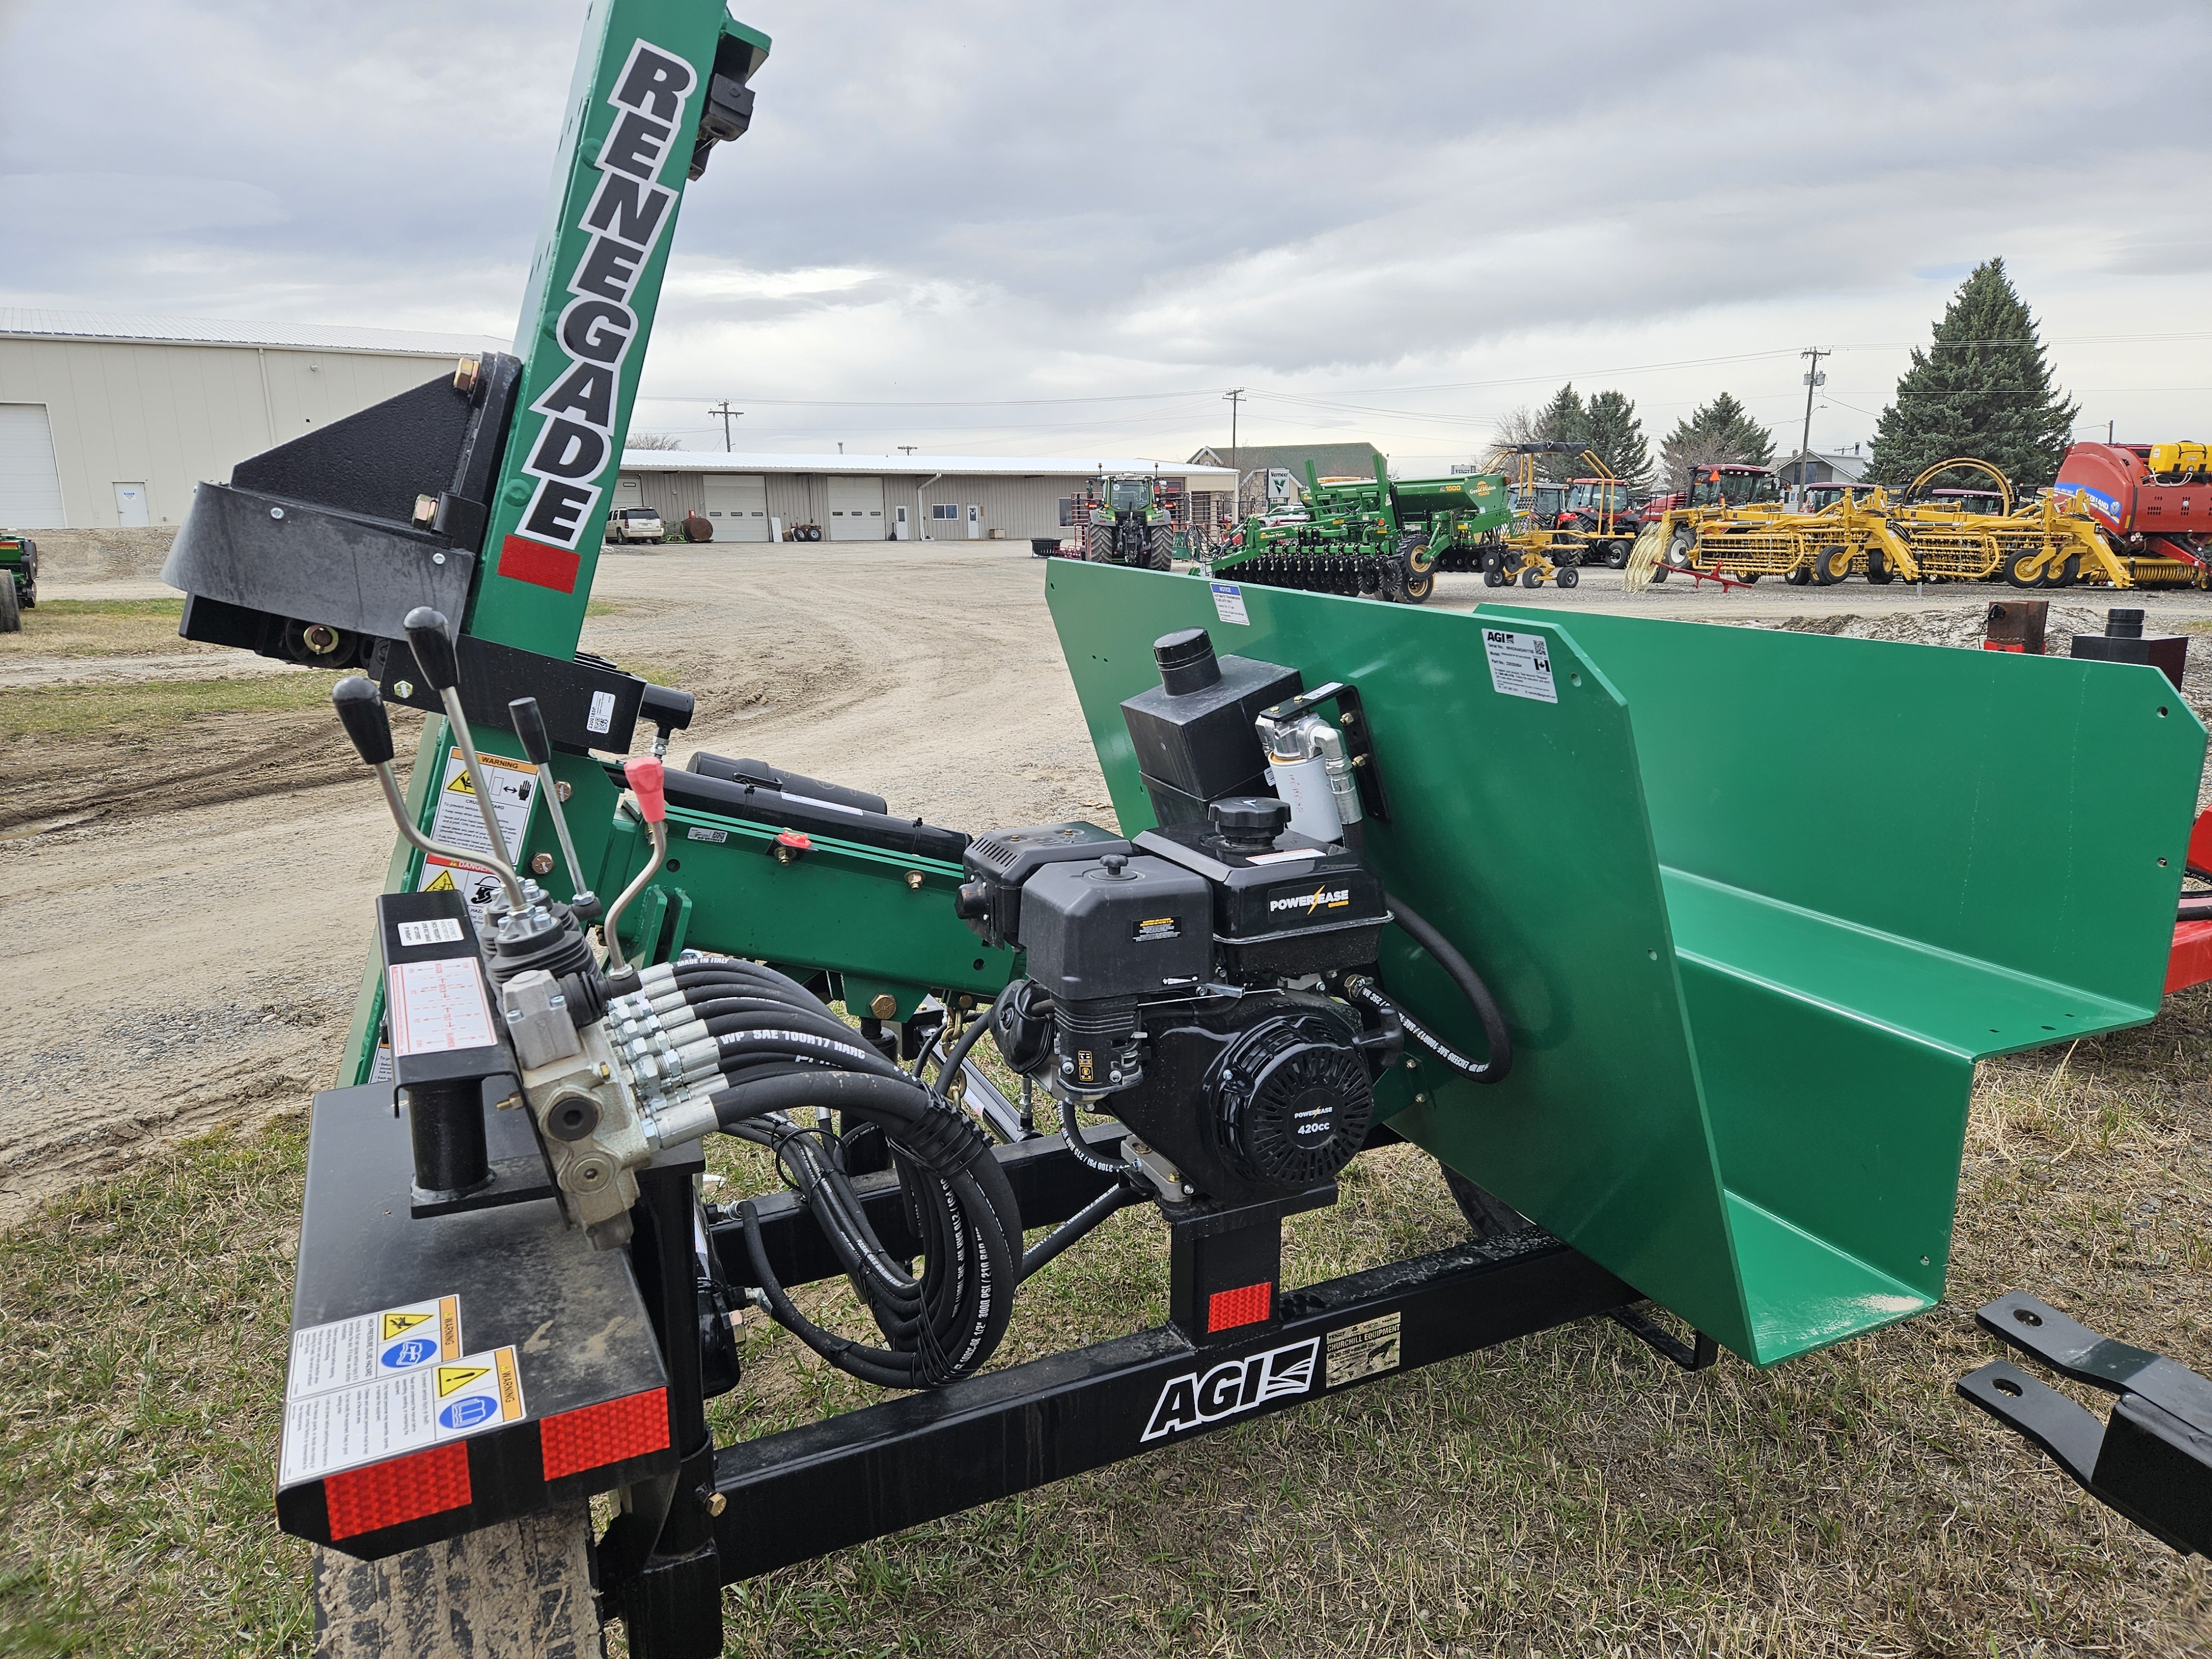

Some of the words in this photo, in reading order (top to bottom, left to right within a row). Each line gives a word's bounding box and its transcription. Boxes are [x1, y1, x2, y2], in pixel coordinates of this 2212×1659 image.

[514, 38, 698, 550] RENEGADE
[1487, 632, 1505, 643] AGI
[482, 757, 519, 769] WARNING
[677, 958, 698, 967] MADE
[720, 1031, 744, 1045] WP
[753, 1030, 779, 1040] SAE
[782, 1031, 830, 1048] 100R17
[1437, 1045, 1451, 1057] SAE
[1087, 1157, 1098, 1168] PSI
[1098, 1162, 1113, 1173] 3100
[980, 1284, 992, 1300] PSI
[978, 1298, 990, 1319] 3000
[444, 1316, 454, 1346] WARNING
[1327, 1334, 1362, 1352] CHURCHILL
[1364, 1323, 1400, 1341] EQUIPMENT
[502, 1371, 515, 1403] WARNING
[1140, 1355, 1265, 1442] AGI
